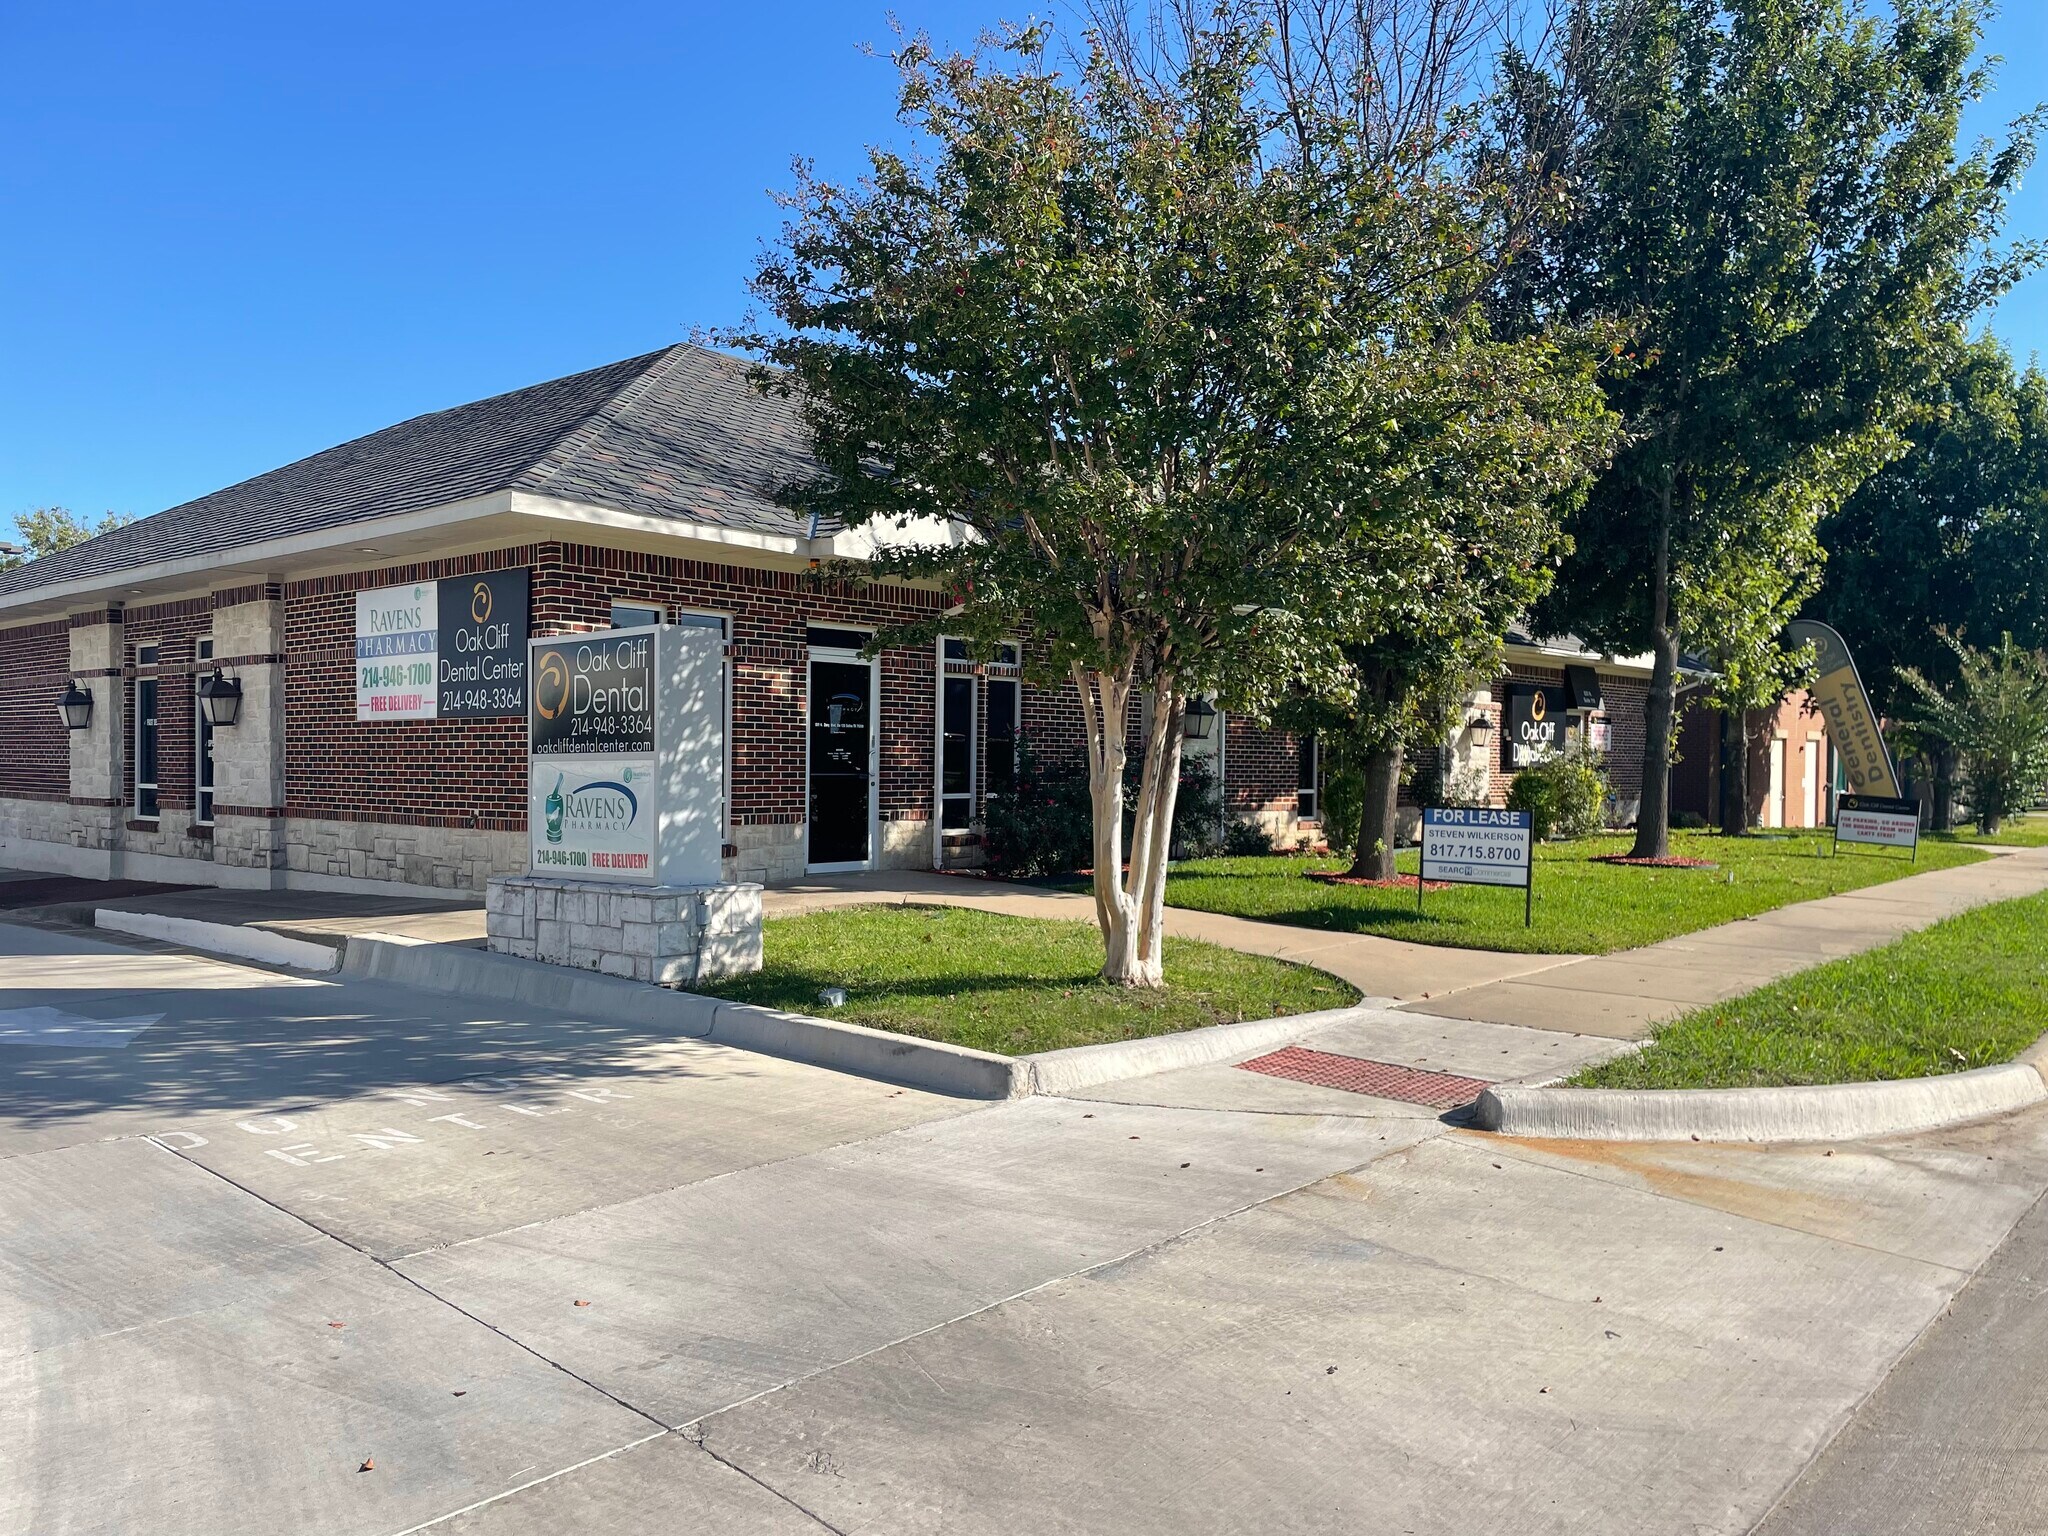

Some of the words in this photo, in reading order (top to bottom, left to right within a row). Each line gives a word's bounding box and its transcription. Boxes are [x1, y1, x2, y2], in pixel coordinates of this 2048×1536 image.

[370, 607, 421, 633] RAVENS
[357, 632, 436, 657] PHARMACY
[455, 626, 483, 653] Oak
[485, 623, 509, 650] Cliff
[576, 643, 611, 673] Oak
[616, 639, 648, 670] Cliff
[362, 662, 432, 689] 214-946-1700
[440, 655, 480, 683] Dental
[482, 655, 524, 680] Center
[371, 696, 387, 712] FREE
[388, 694, 422, 712] DELIVERY
[442, 686, 522, 711] 214-948-3364
[573, 668, 649, 715] Dental
[571, 715, 652, 736] 214-948-3364
[1521, 721, 1539, 740] Oak
[1540, 721, 1556, 740] Cliff
[1841, 683, 1884, 783] Dentistry
[537, 737, 651, 754] oakcliffdentalcenter.com
[1822, 697, 1865, 788] General
[565, 794, 625, 820] RAVENS
[1433, 809, 1465, 823] FOR
[1469, 810, 1521, 826] LEASE
[564, 819, 626, 831] PHARMACY
[1428, 829, 1465, 839] STEVEN
[1467, 831, 1525, 842] WILKERSON
[537, 849, 587, 867] 214-946-1700
[592, 852, 610, 868] FREE
[611, 853, 649, 869] DELIVERY
[1430, 843, 1521, 861] 817.715.8700
[141, 1118, 298, 1153] DO
[389, 1066, 576, 1108] NOT
[263, 1087, 635, 1167] ENTER
